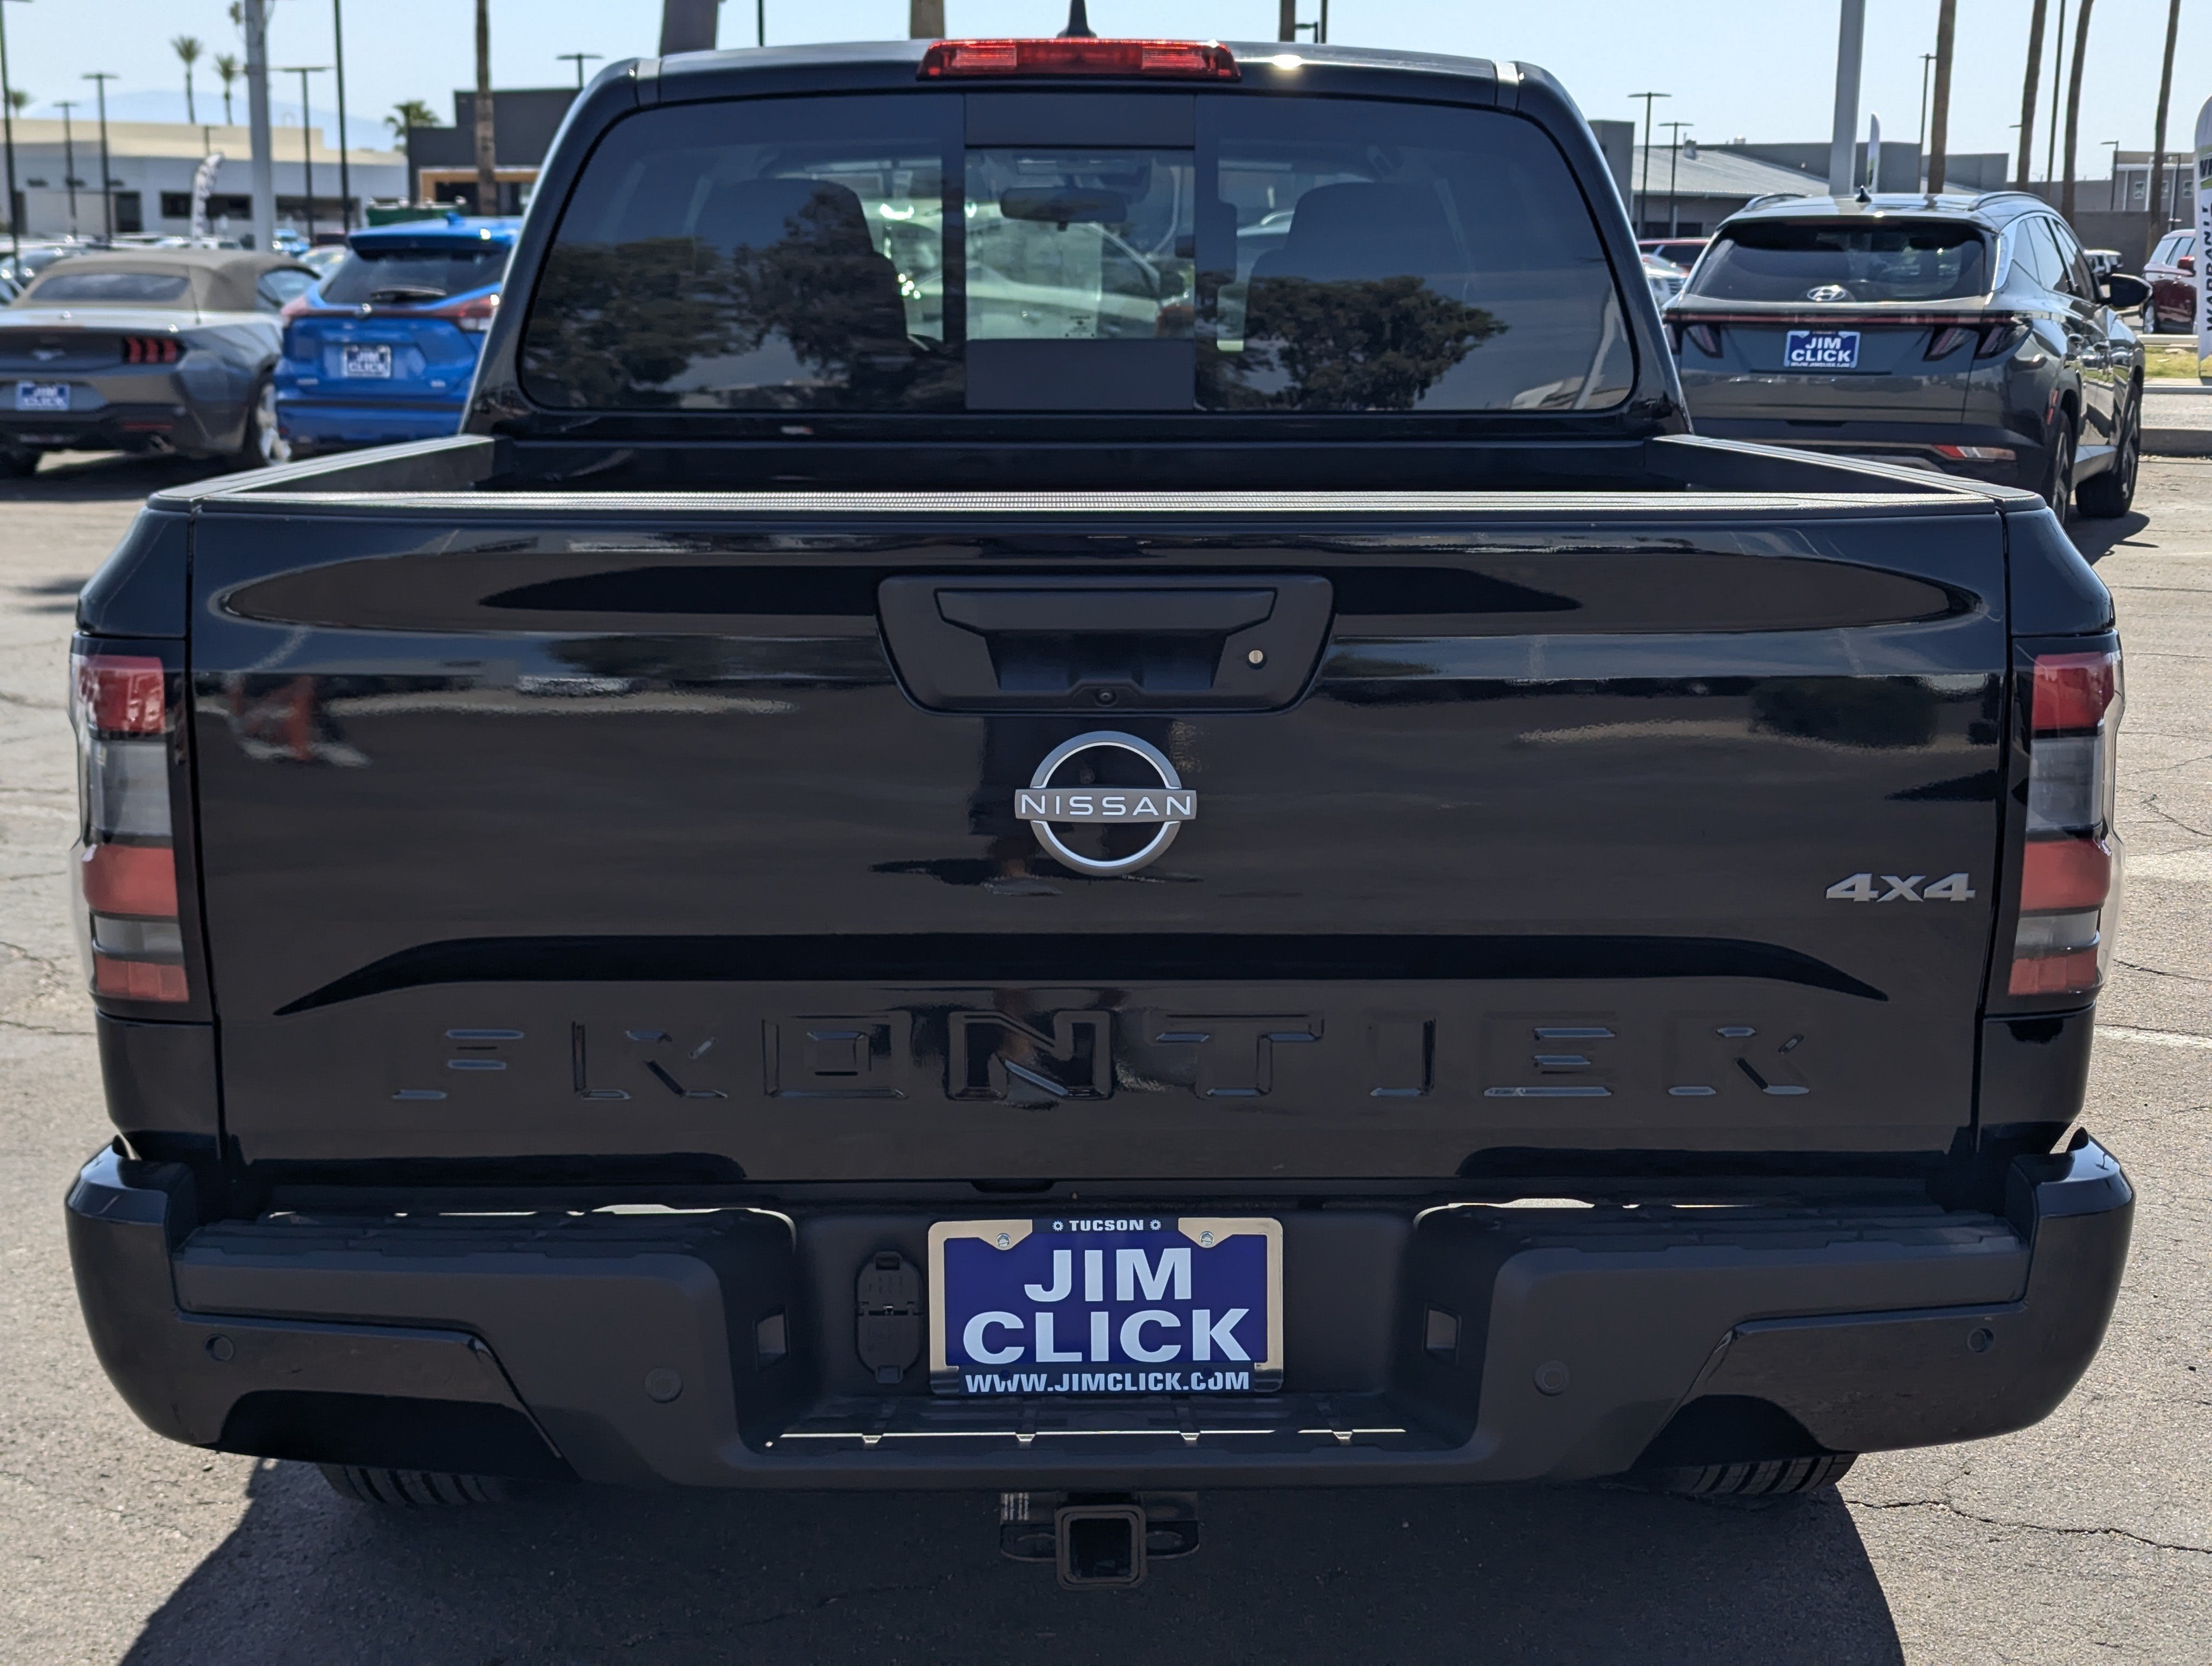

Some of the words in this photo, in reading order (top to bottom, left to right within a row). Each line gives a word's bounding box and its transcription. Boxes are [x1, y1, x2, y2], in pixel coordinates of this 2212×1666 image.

[1805, 337, 1841, 349] JIM
[1791, 349, 1851, 362] CLICK
[1021, 794, 1191, 816] NISSAN
[389, 1010, 1811, 1101] FRONTIER
[1069, 1219, 1144, 1232] TUCSON
[1024, 1247, 1192, 1302] JIM
[963, 1308, 1251, 1364] CLICK
[965, 1372, 1250, 1393] WWW.JIMCLICK.COM
